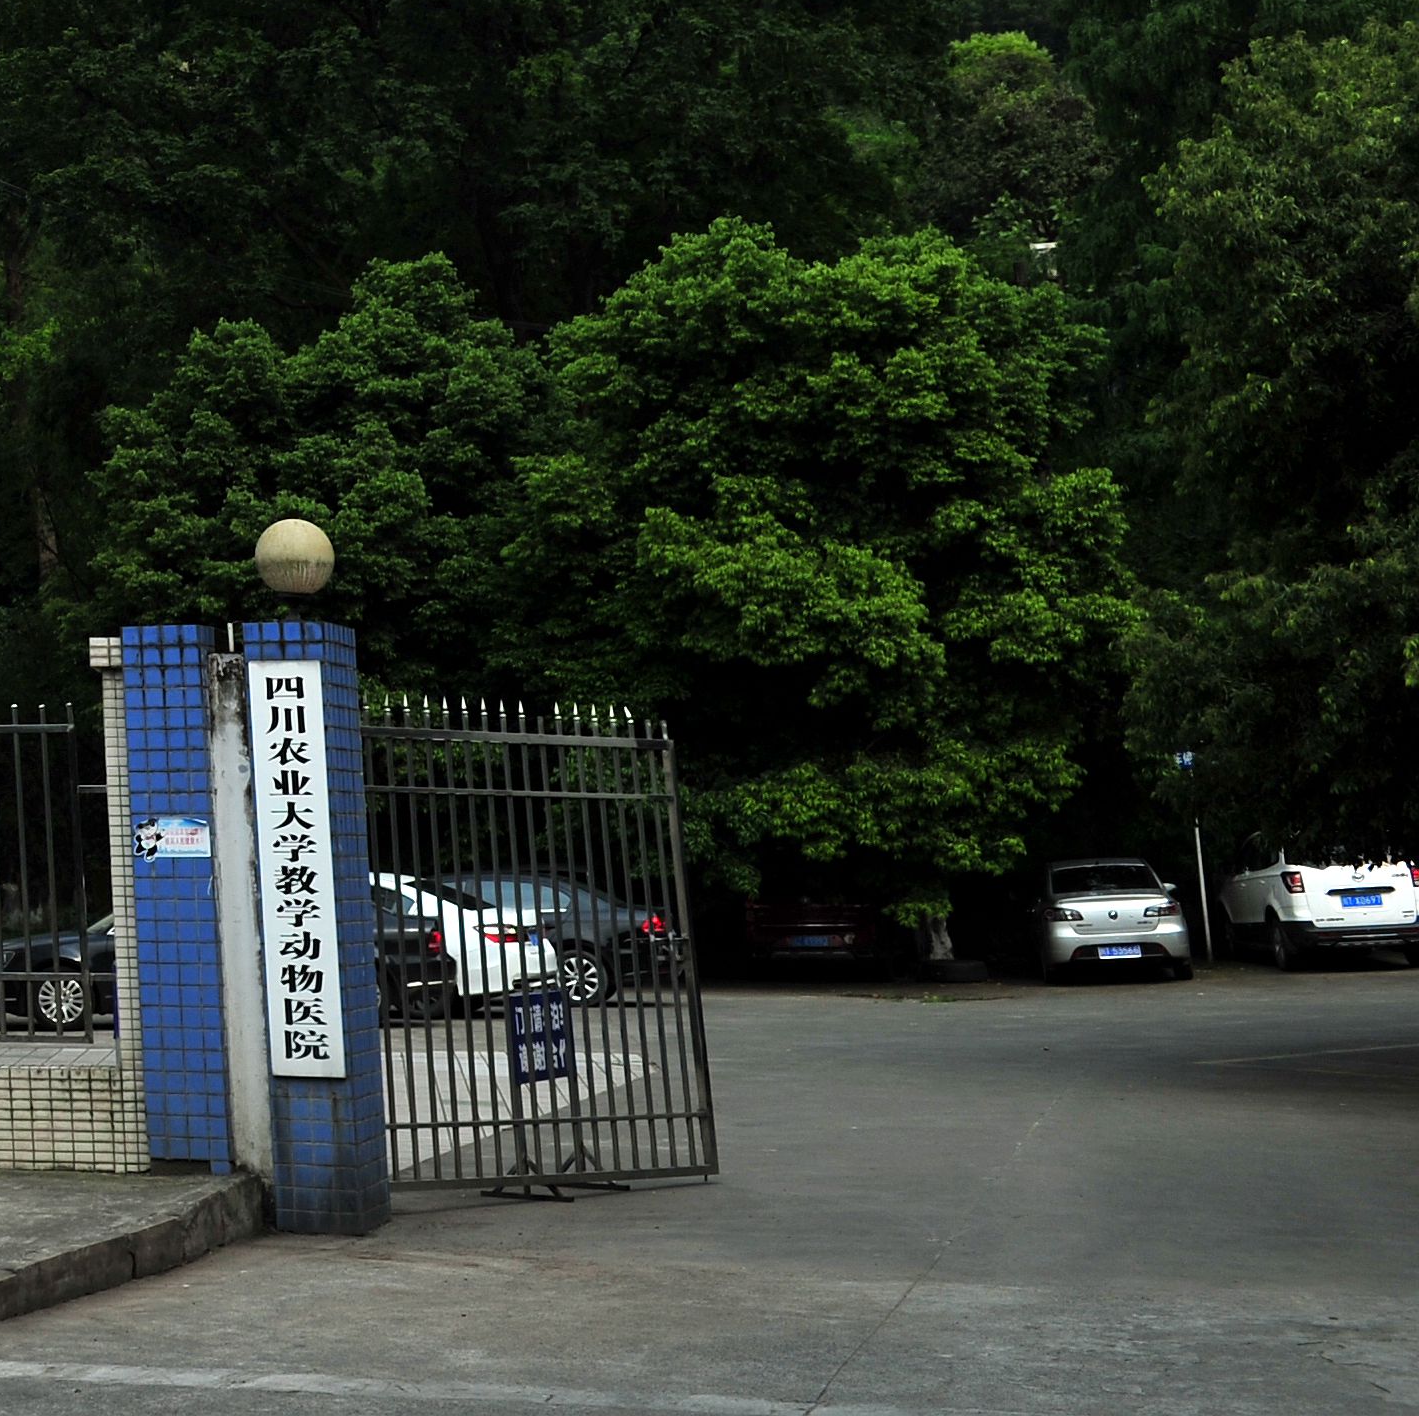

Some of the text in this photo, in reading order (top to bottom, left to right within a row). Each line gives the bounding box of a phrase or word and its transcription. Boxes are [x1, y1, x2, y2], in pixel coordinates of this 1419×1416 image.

[264, 675, 330, 1061] 四川农业大学教学动物医院
